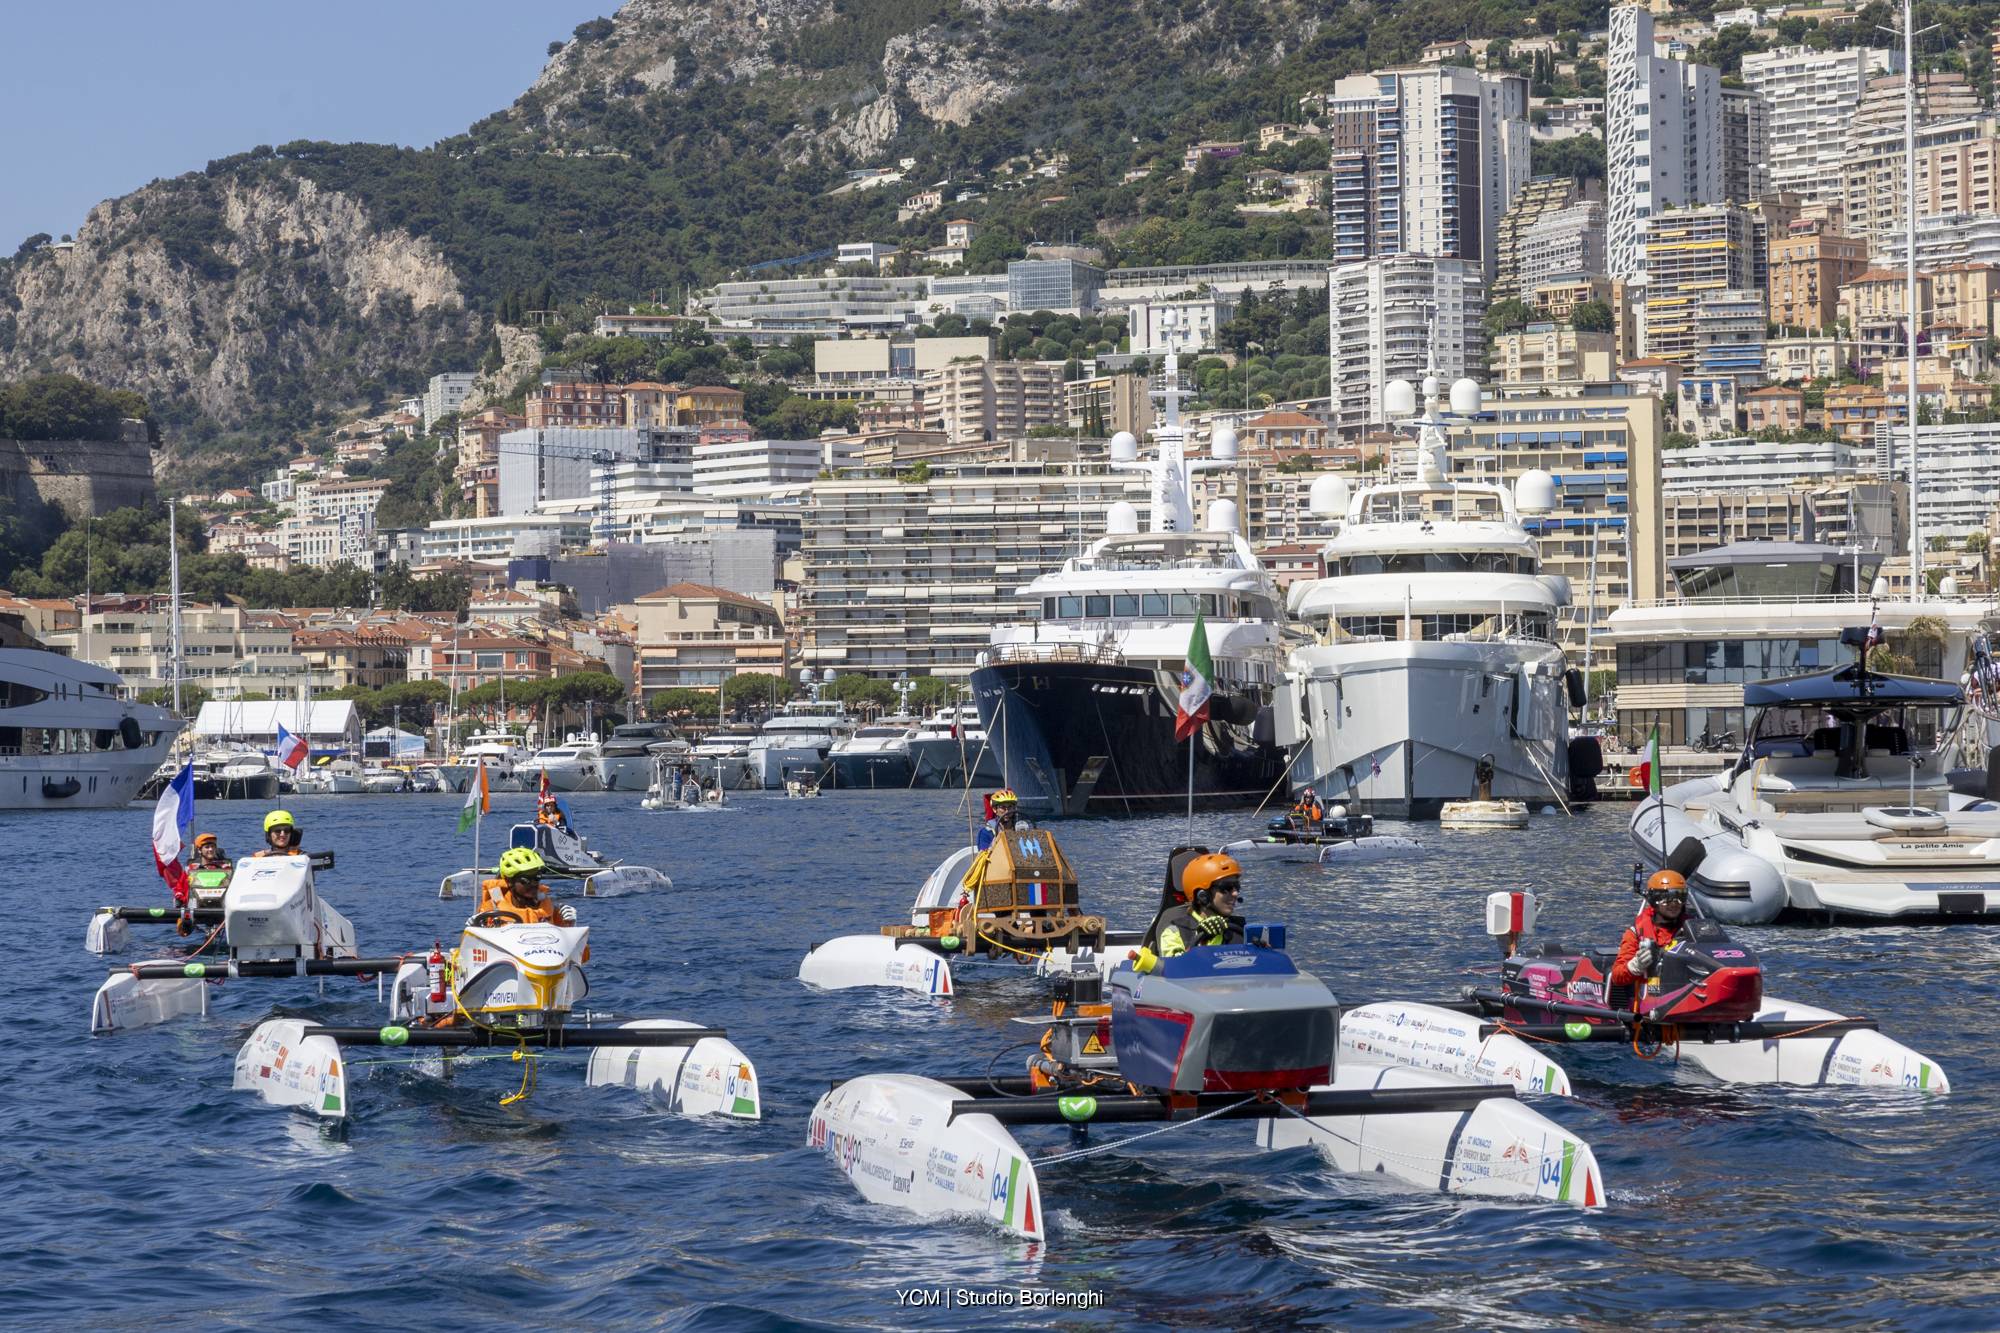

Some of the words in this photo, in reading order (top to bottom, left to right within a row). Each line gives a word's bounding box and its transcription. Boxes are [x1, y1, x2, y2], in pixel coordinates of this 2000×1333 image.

[524, 949, 565, 958] SAKTHI
[727, 1075, 737, 1096] 16
[1541, 1156, 1561, 1188] 04
[993, 1172, 1008, 1204] 04
